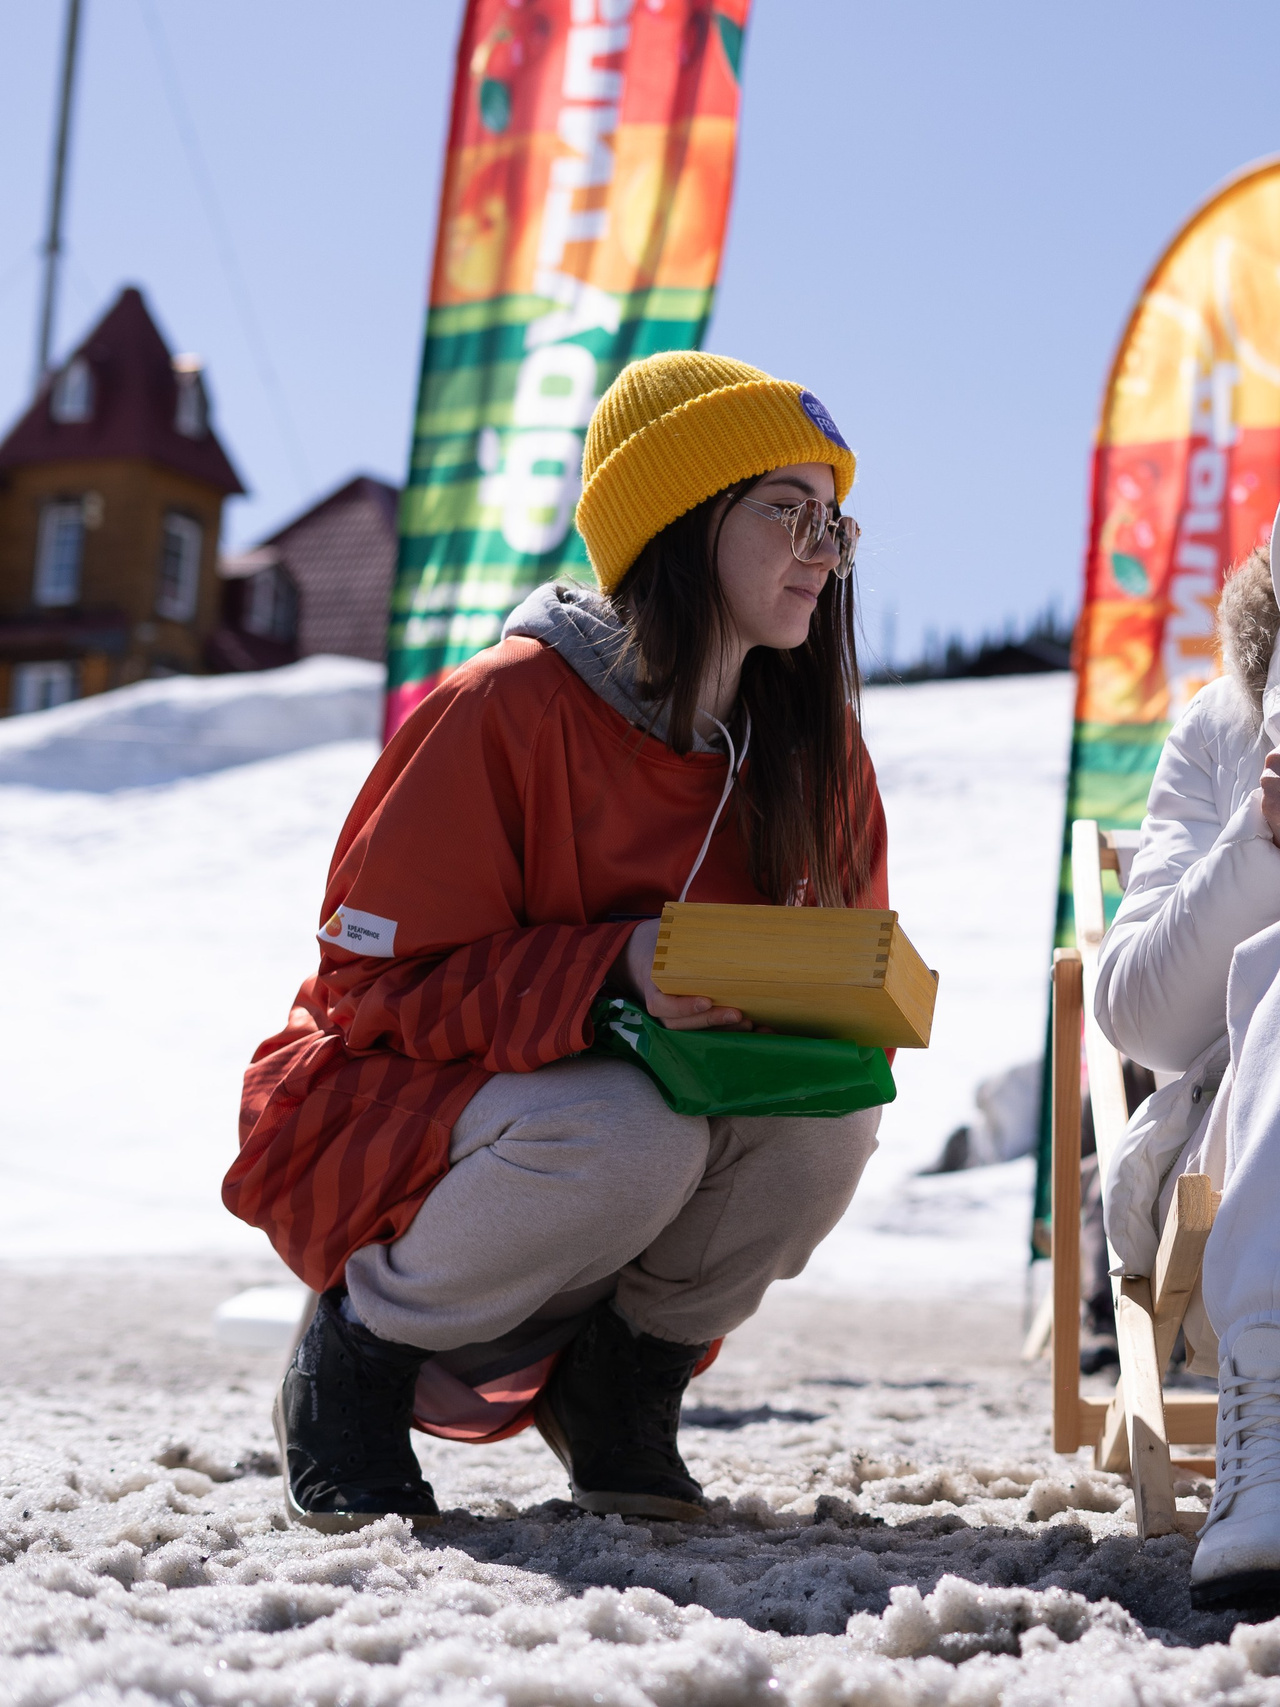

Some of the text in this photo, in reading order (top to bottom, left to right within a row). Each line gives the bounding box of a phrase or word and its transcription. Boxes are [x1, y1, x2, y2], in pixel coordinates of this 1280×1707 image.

[1160, 361, 1242, 720] тилад
[347, 924, 380, 940] КРЕАТИВНОЕ
[347, 931, 362, 941] БЮРО
